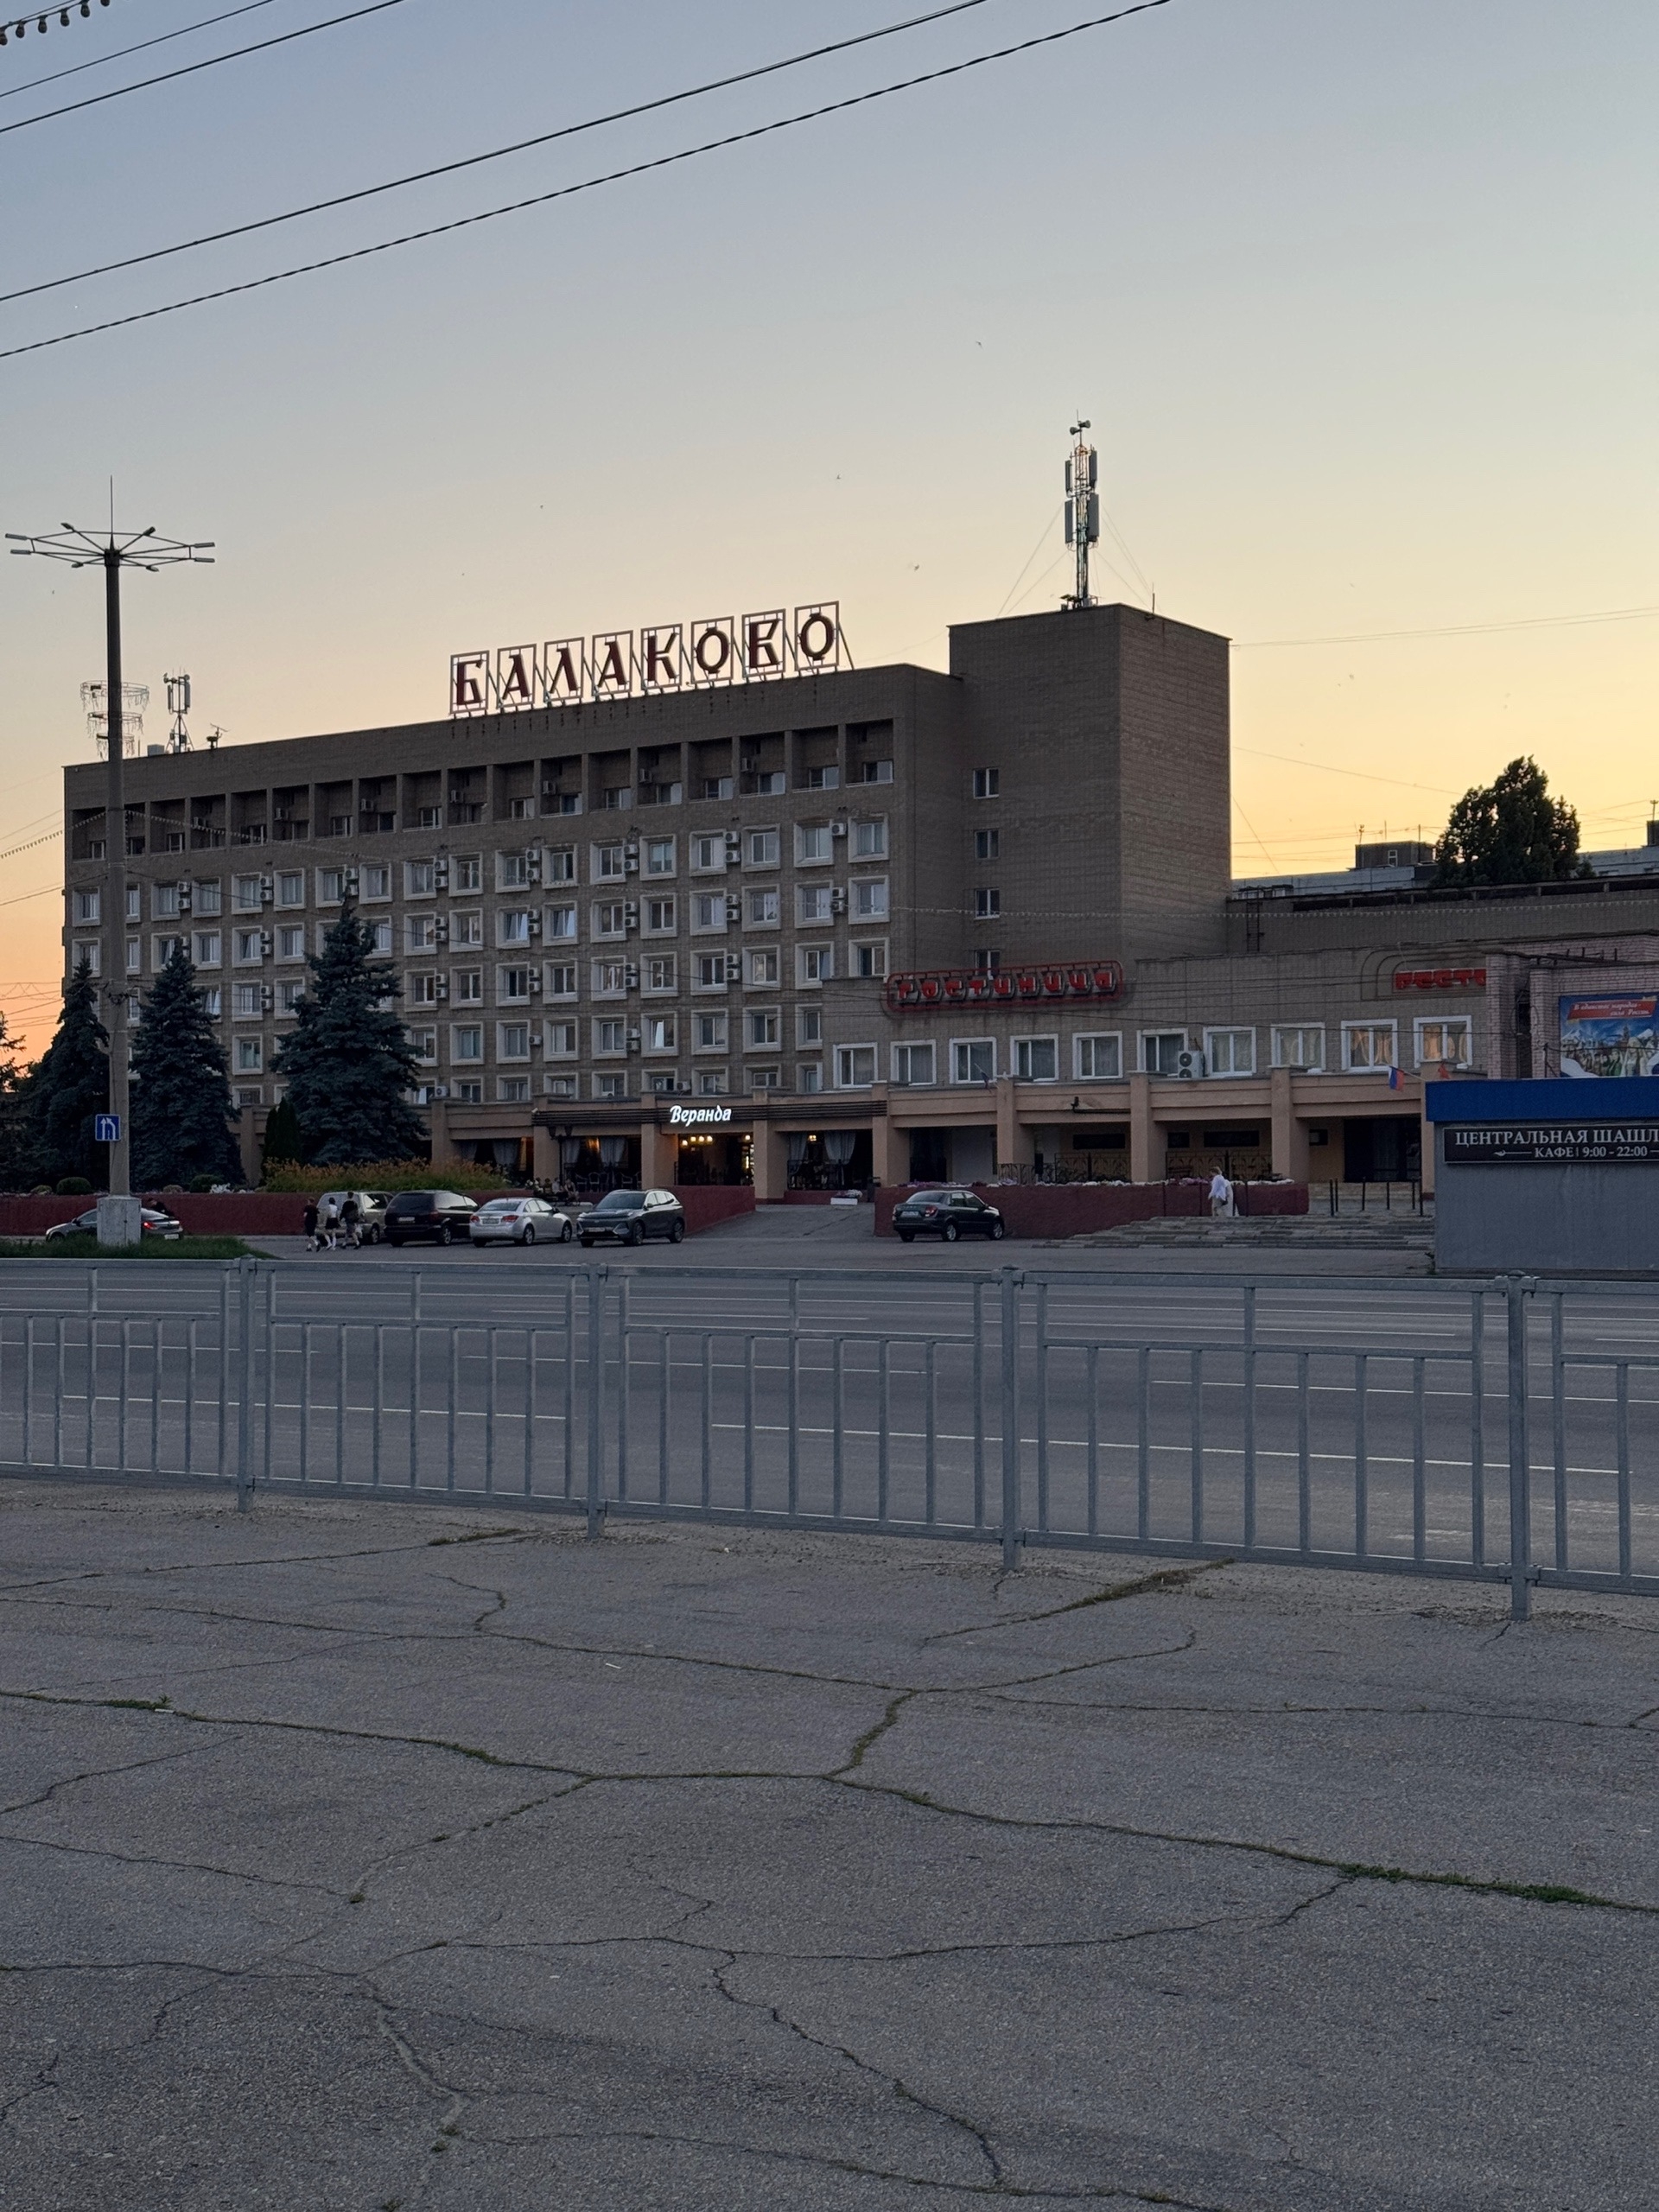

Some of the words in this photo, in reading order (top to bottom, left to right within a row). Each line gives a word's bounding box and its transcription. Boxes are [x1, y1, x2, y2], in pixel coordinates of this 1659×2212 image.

[456, 613, 835, 706] БАЛАКОВО
[898, 970, 1114, 1001] ГОСТИНИЦА
[670, 1105, 732, 1127] Веранда
[1455, 1130, 1588, 1147] ЦЕНТРАЛЬНАЯ
[1535, 1147, 1574, 1158] КАФЕ
[1582, 1147, 1607, 1158] 9:00
[1617, 1146, 1648, 1158] 22:00
